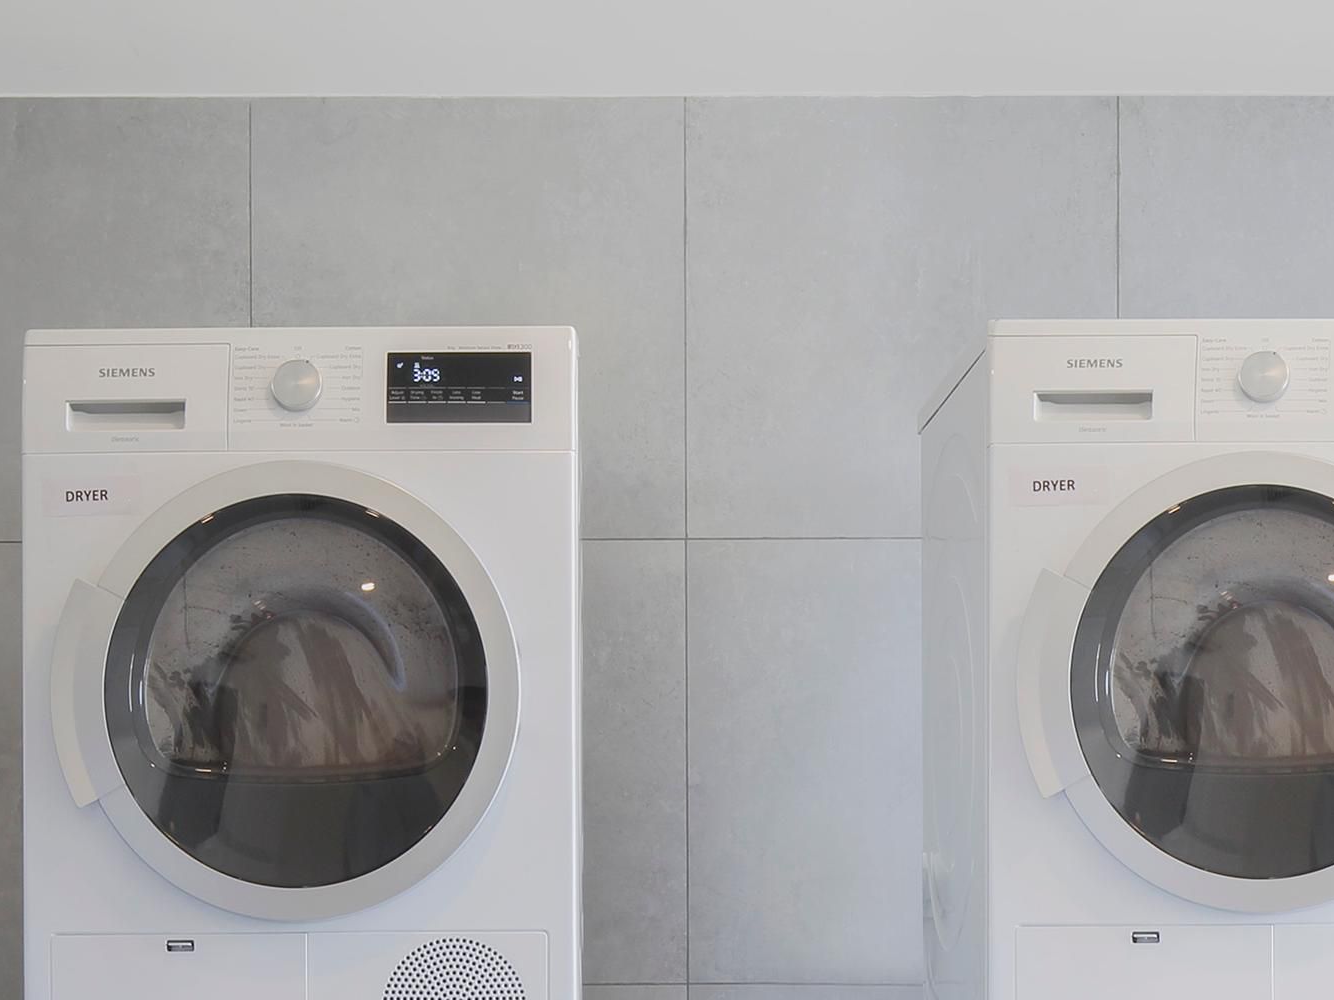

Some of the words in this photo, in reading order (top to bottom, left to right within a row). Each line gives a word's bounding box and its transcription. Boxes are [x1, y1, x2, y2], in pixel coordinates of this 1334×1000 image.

[1066, 359, 1123, 368] SIEMENS
[99, 368, 155, 377] SIEMENS
[412, 368, 440, 382] 3:09
[1033, 479, 1075, 492] DRYER
[65, 489, 108, 502] DRYER
